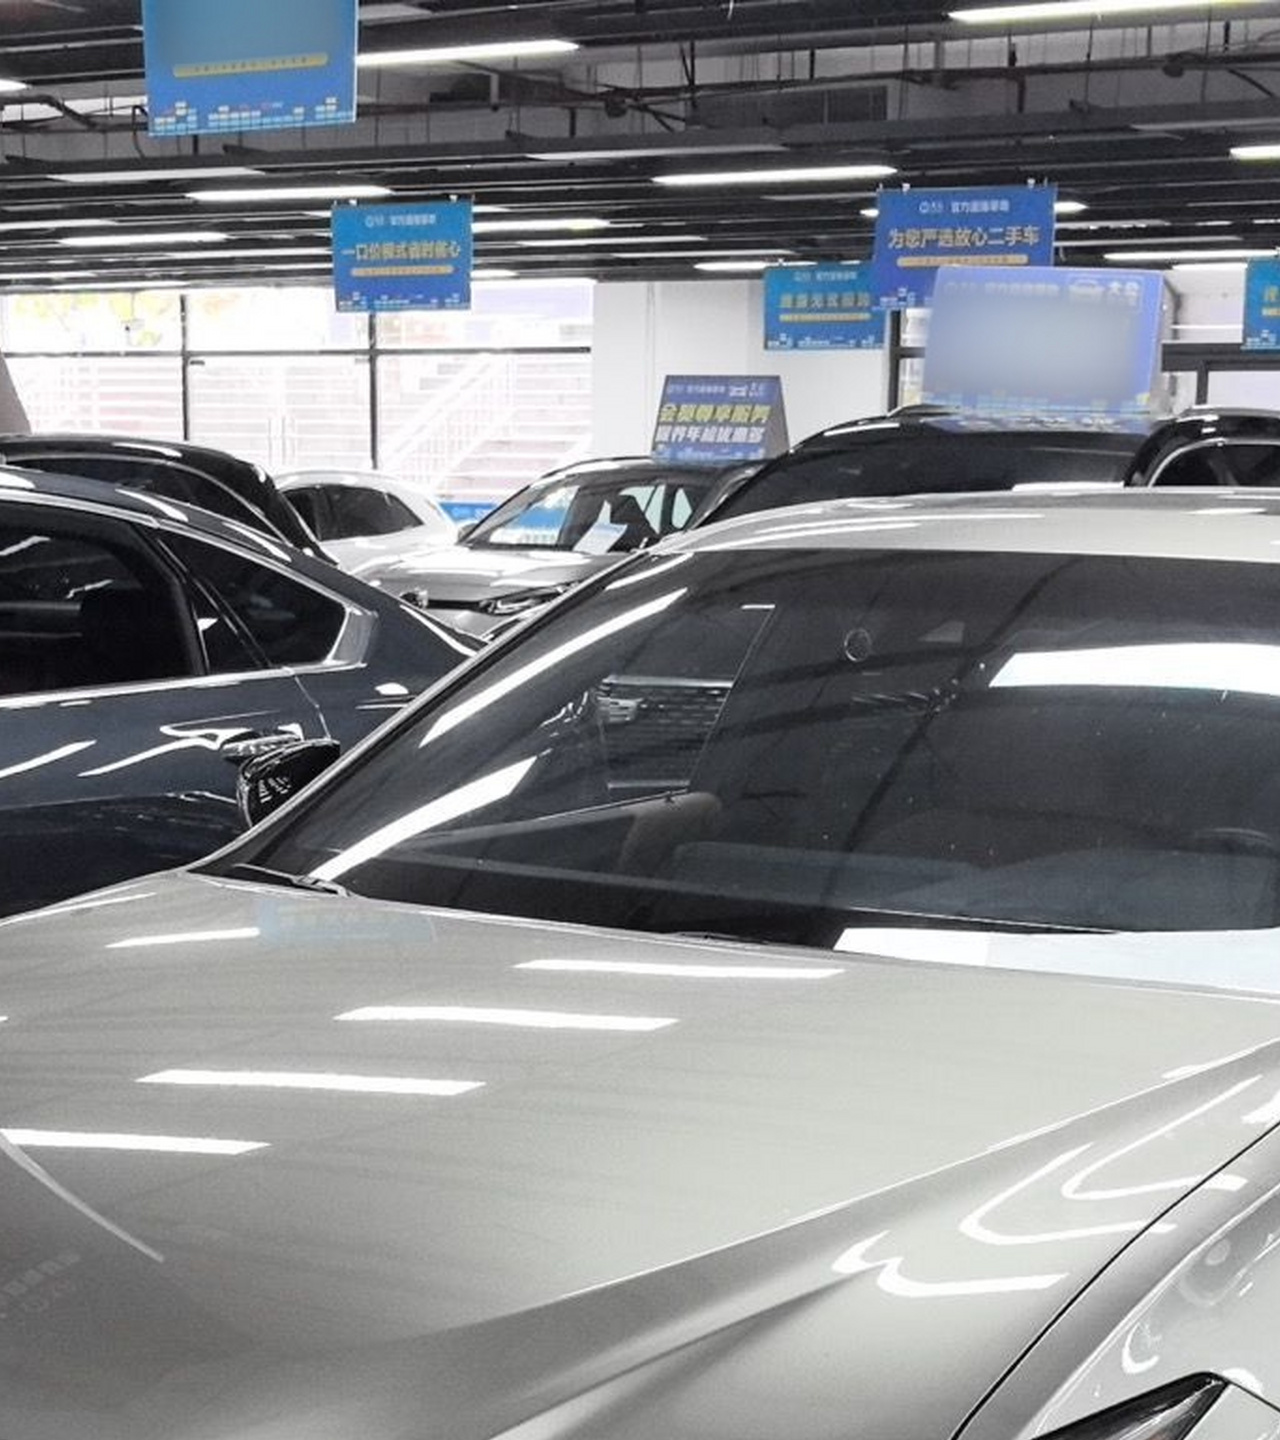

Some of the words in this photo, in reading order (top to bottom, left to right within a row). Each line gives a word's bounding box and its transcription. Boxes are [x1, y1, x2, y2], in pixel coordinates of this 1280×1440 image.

[888, 225, 1041, 249] 为您严选放心二手车
